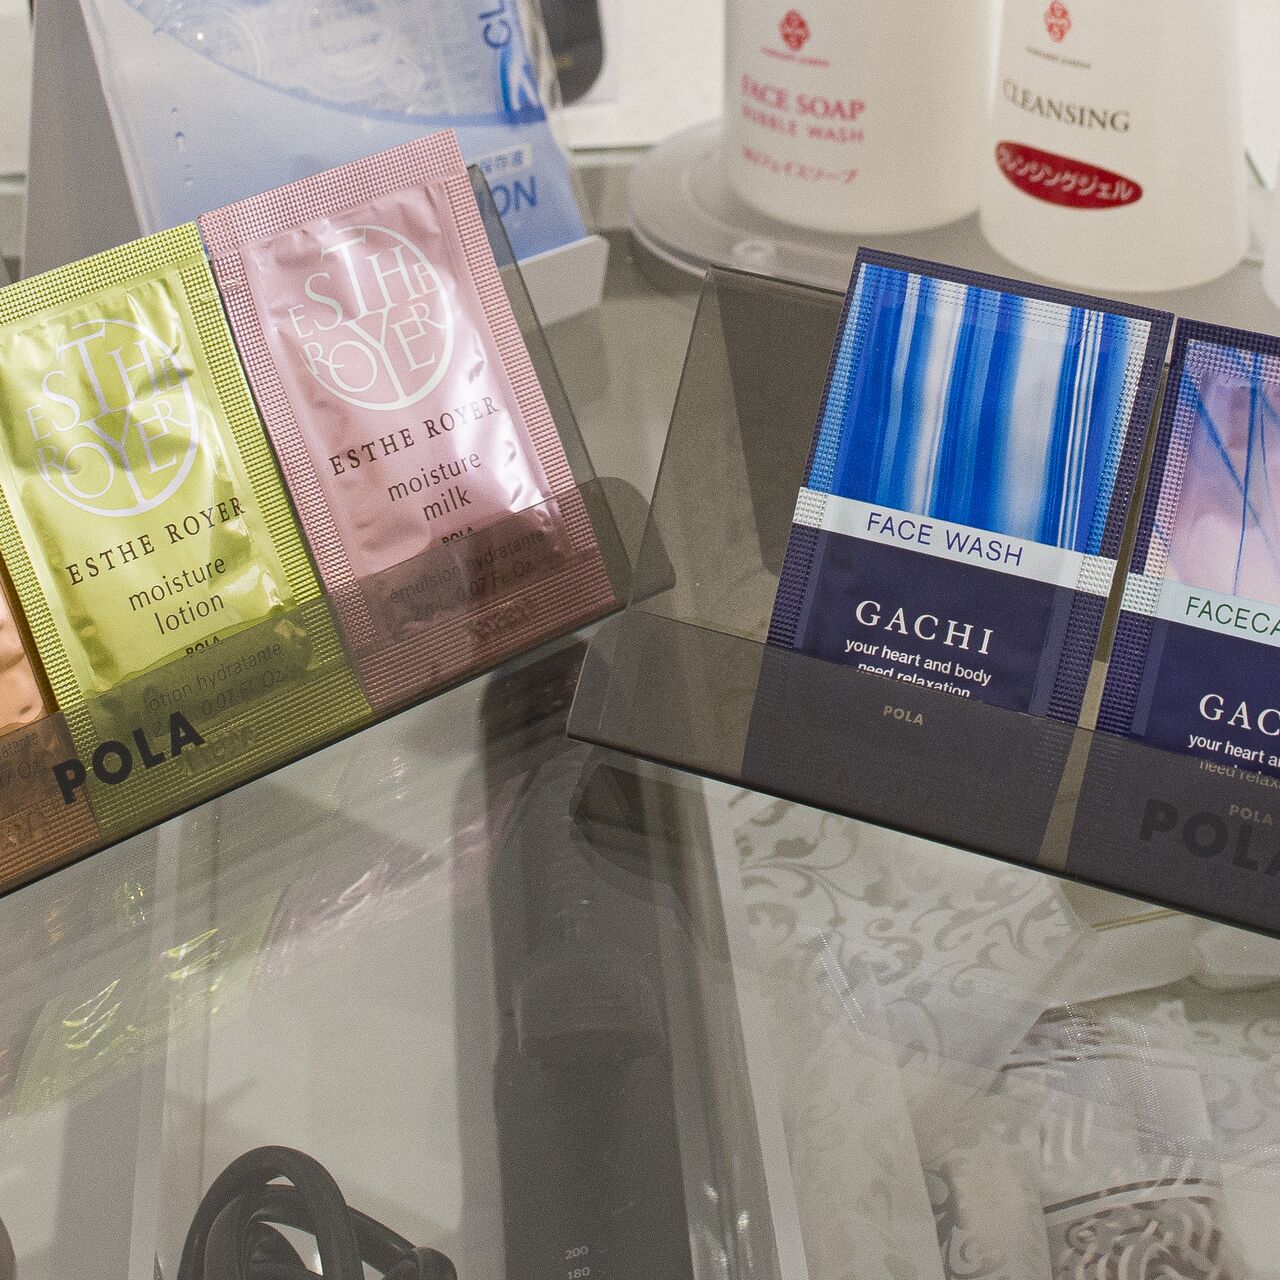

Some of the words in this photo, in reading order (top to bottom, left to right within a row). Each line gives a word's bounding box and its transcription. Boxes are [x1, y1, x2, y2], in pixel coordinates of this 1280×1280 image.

[1003, 78, 1130, 134] CLEANSING
[328, 428, 415, 477] ESTHE
[427, 395, 499, 438] ROYER
[387, 453, 483, 502] moisture
[422, 486, 472, 522] milk
[65, 534, 155, 586] ESTHE
[164, 497, 247, 545] ROYER
[867, 511, 934, 545] FACE
[945, 529, 1023, 567] WASH
[128, 557, 227, 611] moisture
[154, 593, 225, 635] lotion
[855, 599, 994, 655] GACHI
[844, 639, 878, 655] your
[881, 645, 921, 667] heart
[923, 655, 951, 675] and
[954, 662, 992, 687] body
[883, 704, 924, 726] POLA
[52, 711, 206, 805] POLA
[1188, 733, 1222, 751] your
[1224, 741, 1265, 764] heart
[1229, 803, 1273, 825] POLA
[565, 1245, 589, 1260] 200
[567, 1267, 590, 1279] 180
